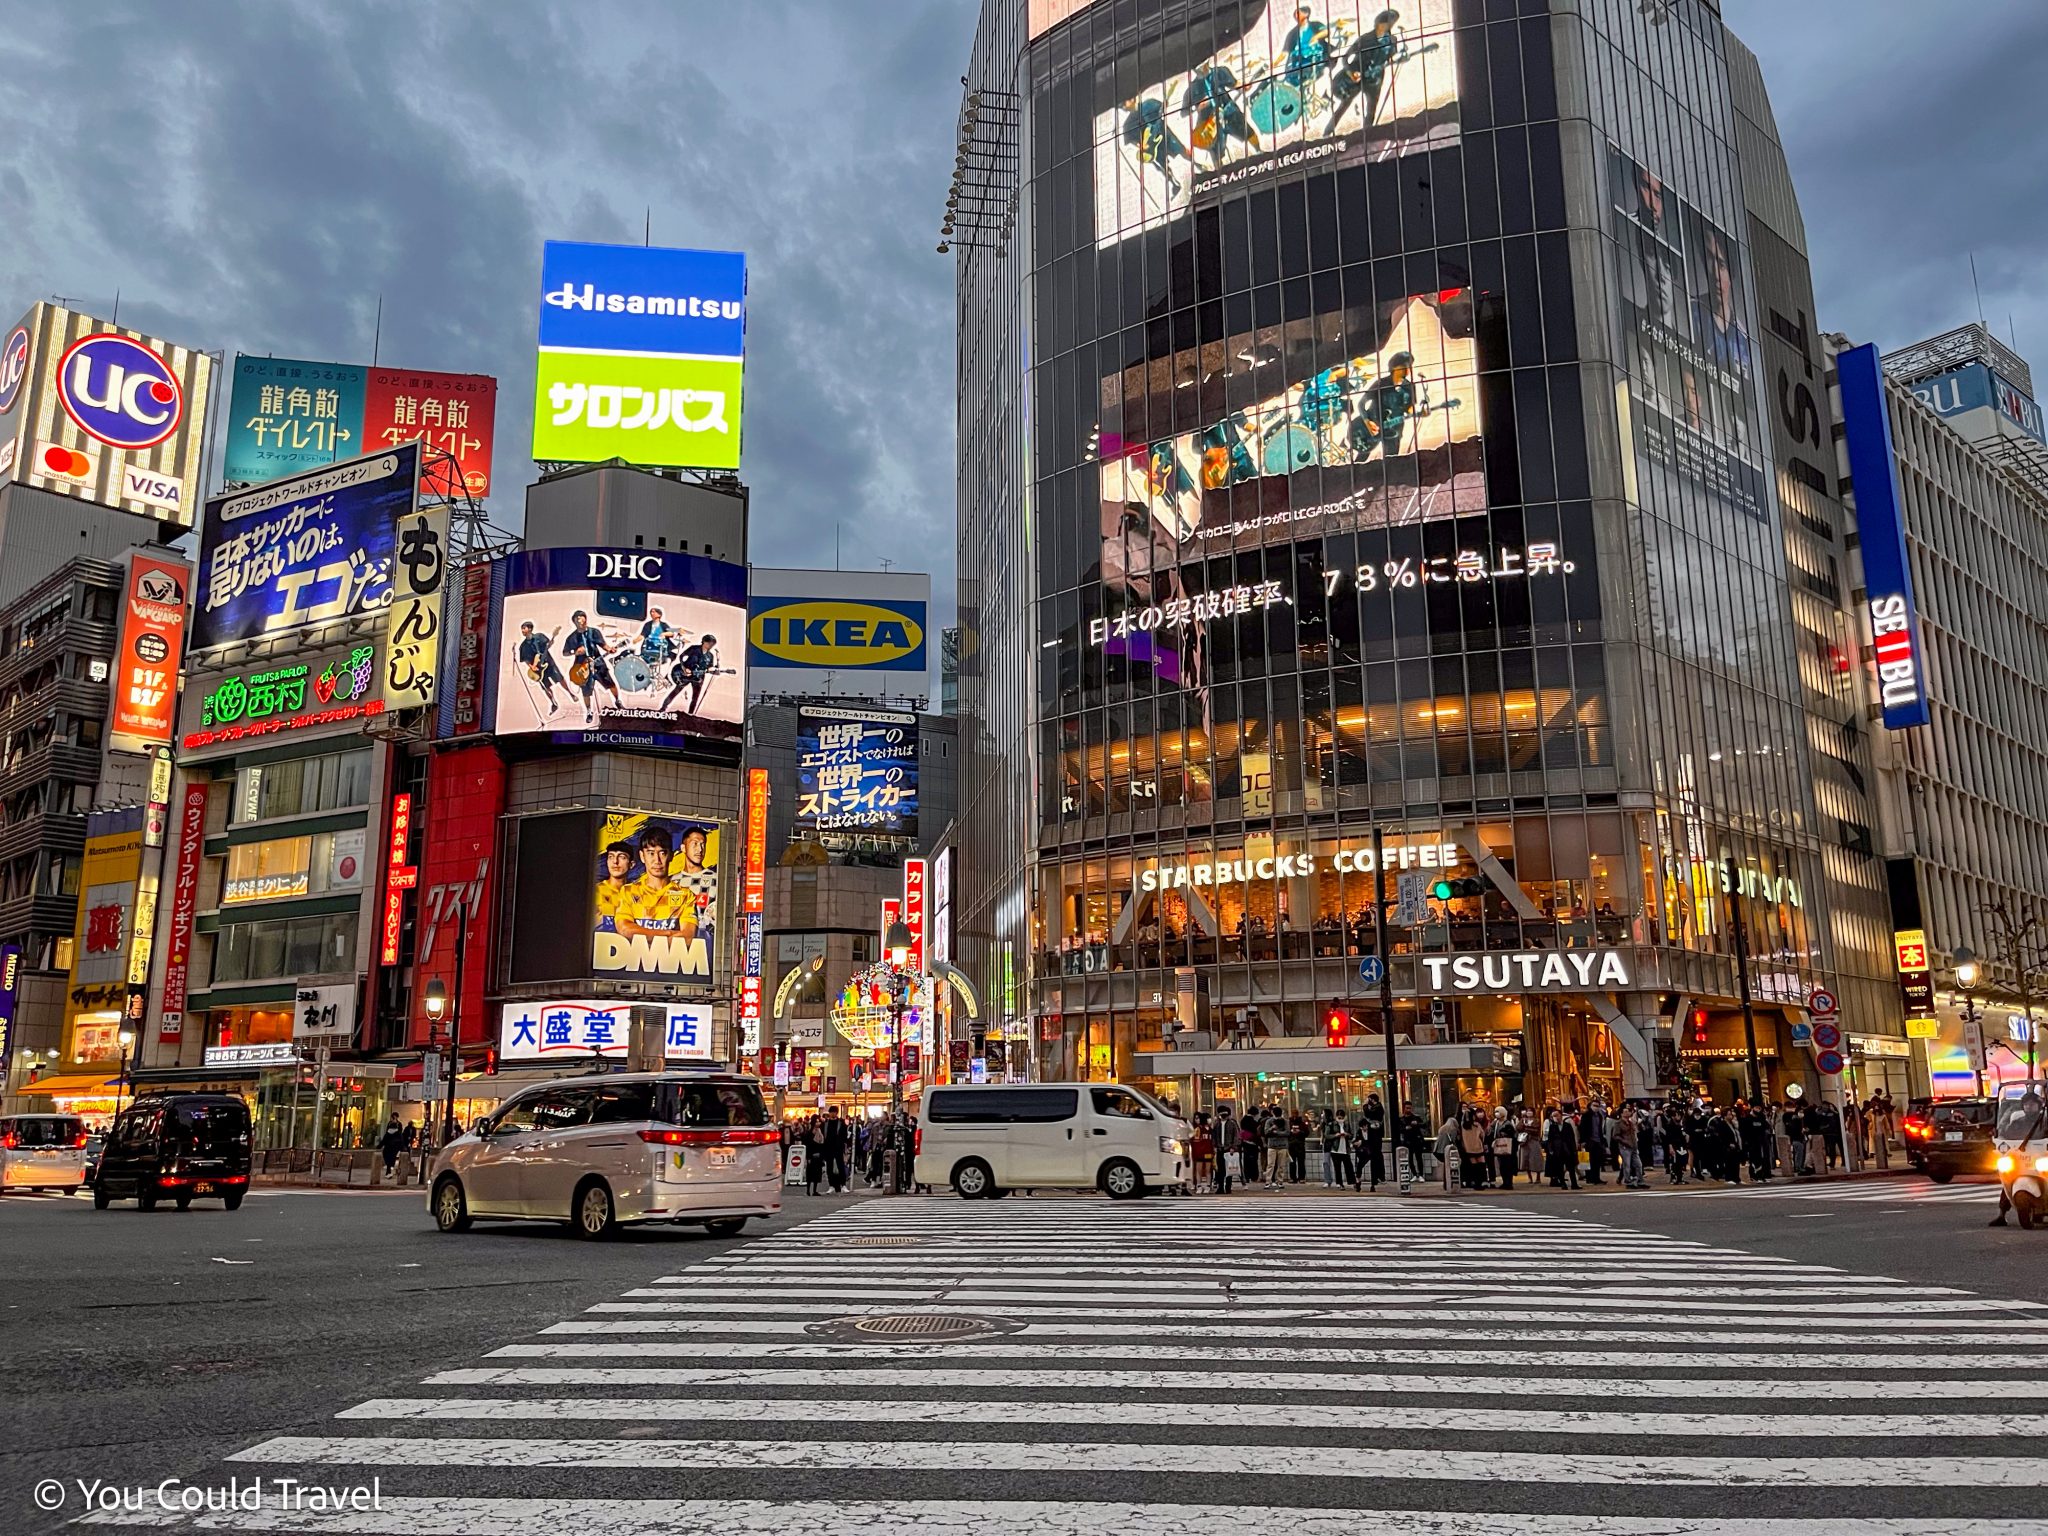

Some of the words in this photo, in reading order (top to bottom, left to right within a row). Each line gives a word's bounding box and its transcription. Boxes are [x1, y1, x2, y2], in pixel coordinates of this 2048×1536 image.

[545, 282, 741, 320] Hisamitsu
[73, 353, 170, 426] UC
[260, 384, 340, 419] 龍角散
[394, 395, 470, 429] 龍角散
[548, 381, 729, 435] サロンパス
[246, 417, 351, 452] ダイレクト
[256, 451, 297, 461] スティック
[44, 470, 87, 486] mastercard
[126, 472, 180, 503] VISA
[227, 467, 368, 516] #プロジェクトワールドチャンピオン
[211, 495, 336, 576] 日本サッカーに
[206, 523, 344, 613] 足りないのは、
[587, 552, 663, 582] DHC
[265, 549, 395, 632] エゴだ。
[388, 515, 443, 701] もんじゃ
[131, 599, 183, 626] VANGUARD
[1090, 579, 1293, 646] 日本の突破確率、
[762, 617, 912, 649] IKEA
[1870, 594, 1918, 709] SEIBU
[133, 667, 166, 687] B1F
[130, 686, 165, 707] B2F
[249, 680, 306, 717] 西村
[583, 733, 608, 743] DHC
[609, 734, 654, 745] Channel
[818, 723, 904, 750] 世界一の
[801, 744, 915, 767] エゴイストでなければ
[817, 763, 904, 791] 世界一の
[798, 784, 916, 817] ストライカー
[751, 773, 765, 864] クスリのことなら
[816, 810, 897, 830] にはなれない。
[174, 807, 201, 953] ウィンターフルーツギフト
[1141, 853, 1316, 893] STARBUCKS
[1333, 843, 1458, 874] COFFEE
[593, 931, 711, 977] DMM
[1422, 952, 1629, 990] TSUTAYA
[1902, 946, 1923, 966] 本
[4, 953, 18, 991] MIZUHO
[511, 1011, 699, 1046] 大盛堂店
[1680, 1047, 1738, 1057] STARBUCKS
